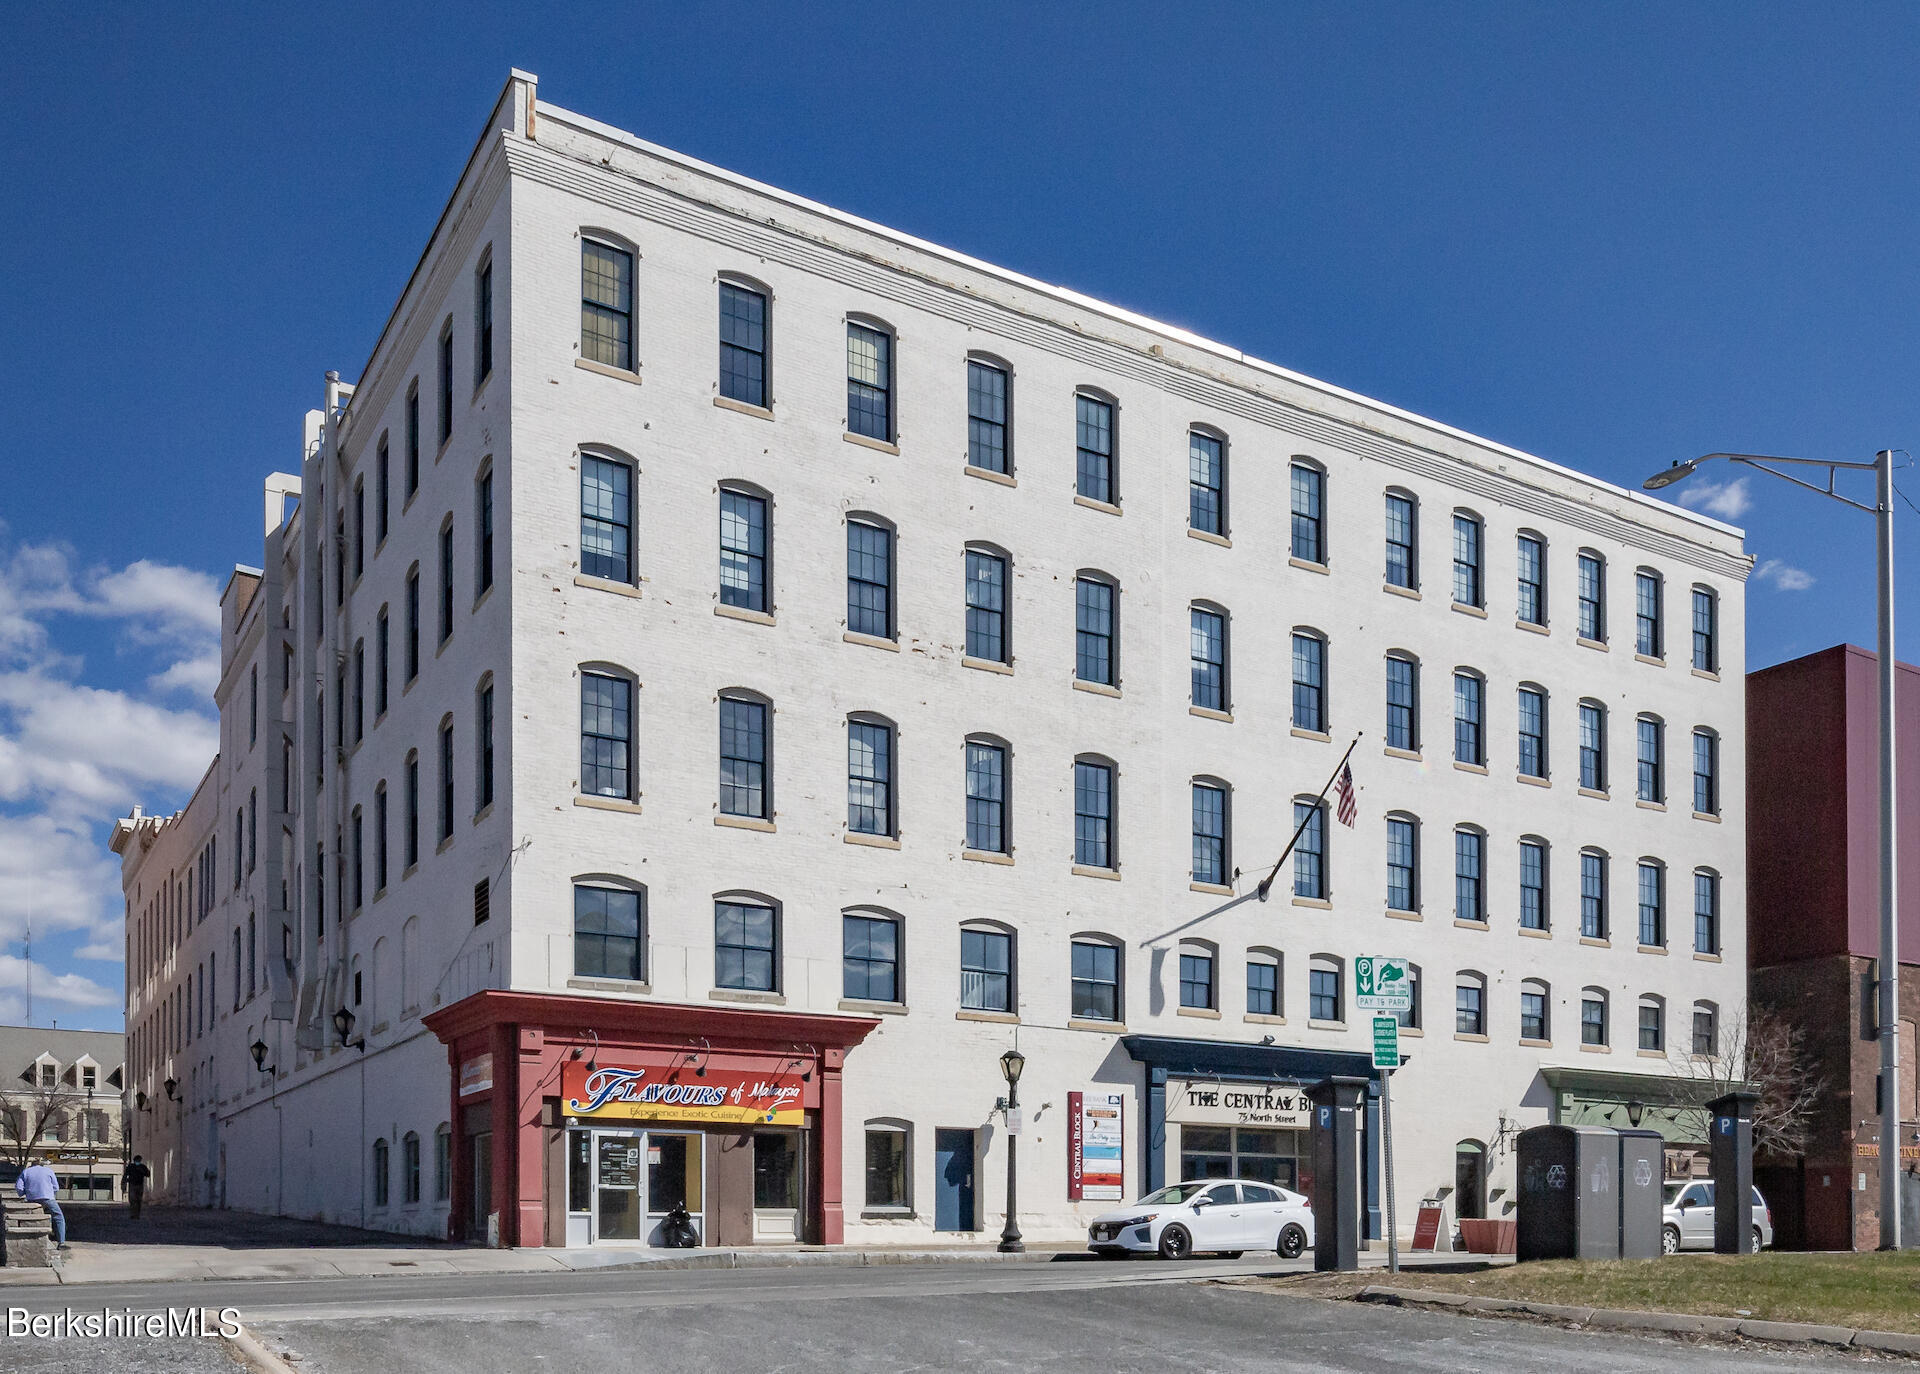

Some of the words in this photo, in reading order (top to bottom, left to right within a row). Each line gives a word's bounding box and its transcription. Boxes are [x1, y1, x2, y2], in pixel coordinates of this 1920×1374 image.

[1360, 997, 1373, 1005] PAY
[1388, 998, 1406, 1006] PARK
[569, 1067, 728, 1113] FLAVOURS
[730, 1081, 746, 1105] of
[747, 1081, 801, 1103] Malaysia
[1187, 1091, 1219, 1107] THE
[1224, 1093, 1294, 1111] CENTRAL
[629, 1107, 679, 1118] Experience
[681, 1109, 708, 1119] Exotic
[710, 1110, 742, 1120] Cuisine
[1250, 1113, 1272, 1122] North
[1274, 1114, 1296, 1124] Street
[1073, 1112, 1081, 1140] BLOCK
[1073, 1140, 1081, 1180] CENTRAL
